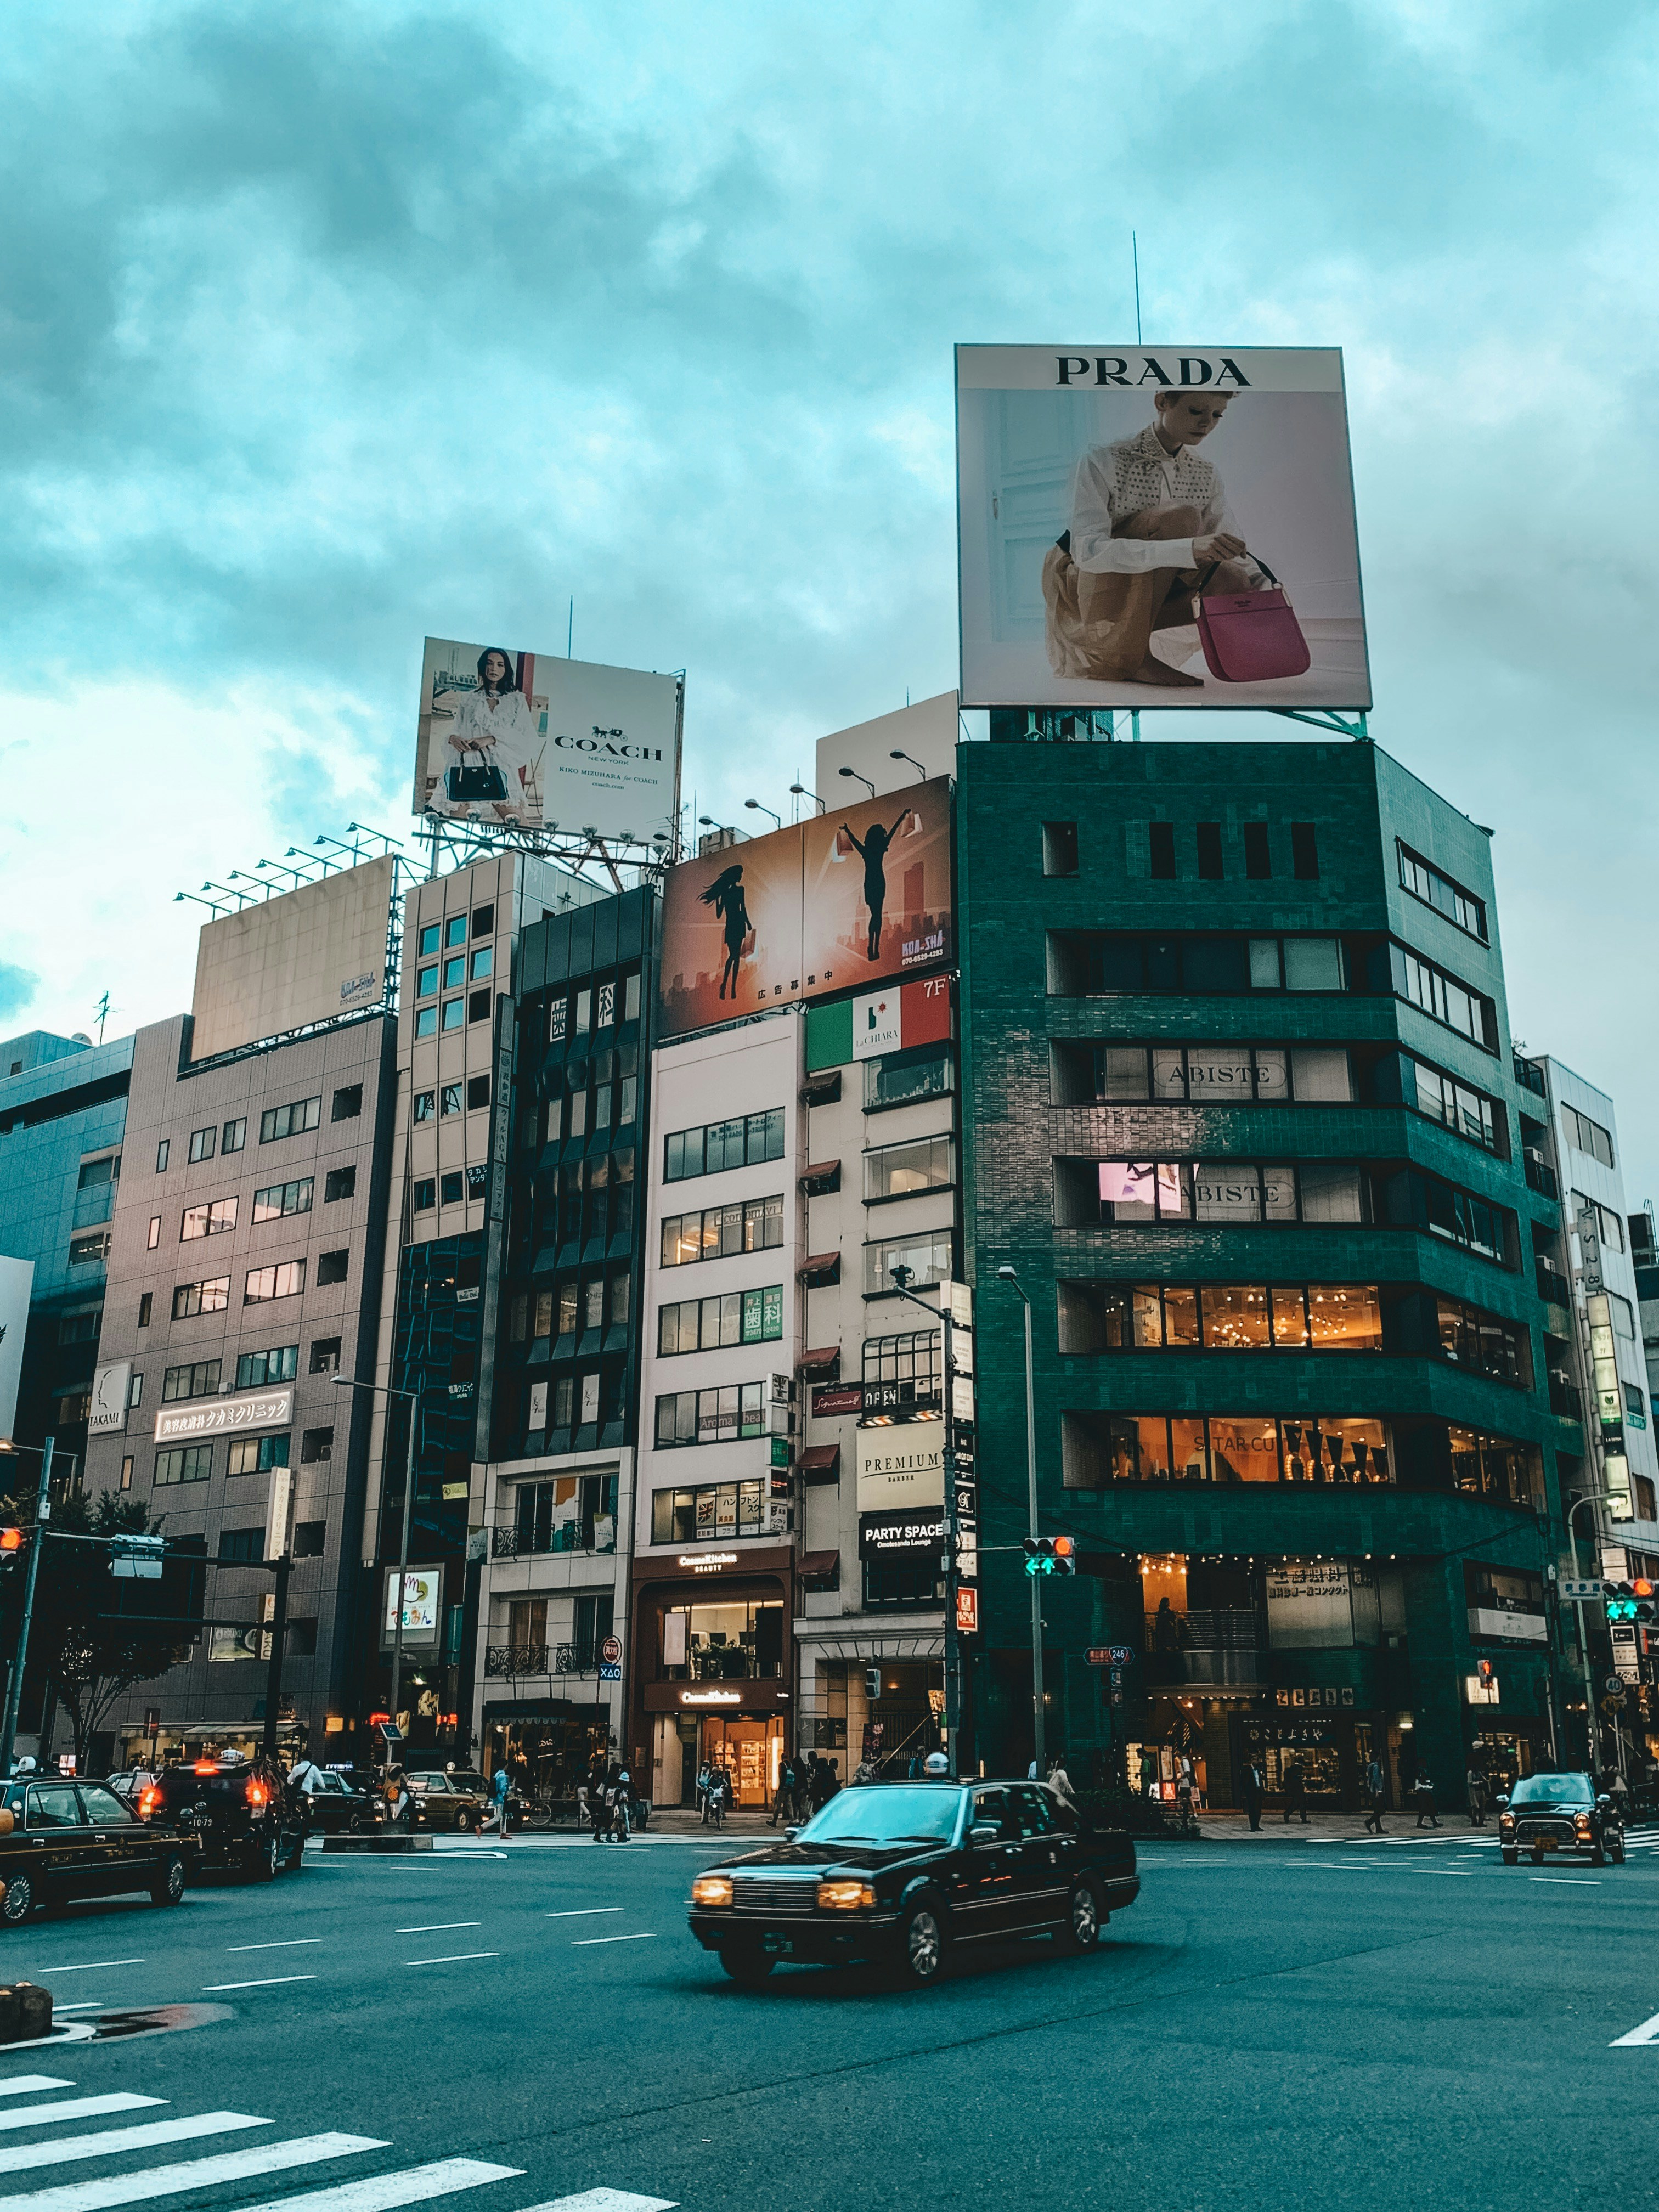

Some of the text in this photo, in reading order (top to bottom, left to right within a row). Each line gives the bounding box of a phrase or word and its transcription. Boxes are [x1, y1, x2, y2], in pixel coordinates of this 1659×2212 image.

[1055, 357, 1252, 386] PRADA
[555, 736, 663, 761] COACH
[581, 769, 621, 780] MIZUHARA
[592, 782, 625, 790] coach.com
[902, 930, 943, 957] KOA-SHA
[758, 970, 833, 1000] 広告募集中
[924, 978, 947, 998] 7F
[865, 1029, 898, 1044] CHIARA
[1169, 1066, 1270, 1082] ABISTE
[1181, 1185, 1279, 1203] ABISTE
[744, 1304, 782, 1329] 歯科
[865, 1390, 896, 1407] OPEN
[89, 1412, 119, 1427] TAKAMI
[206, 1399, 287, 1427] タカミクリニック
[701, 1417, 733, 1427] Aroma
[865, 1453, 939, 1472] PREMIUM
[888, 1475, 915, 1483] BARBER
[865, 1523, 943, 1541] PARTY SPACE
[695, 1564, 722, 1572] BEAUTY
[263, 1611, 274, 1657] RAKU
[1112, 1649, 1125, 1658] 246
[1608, 1680, 1621, 1690] 40
